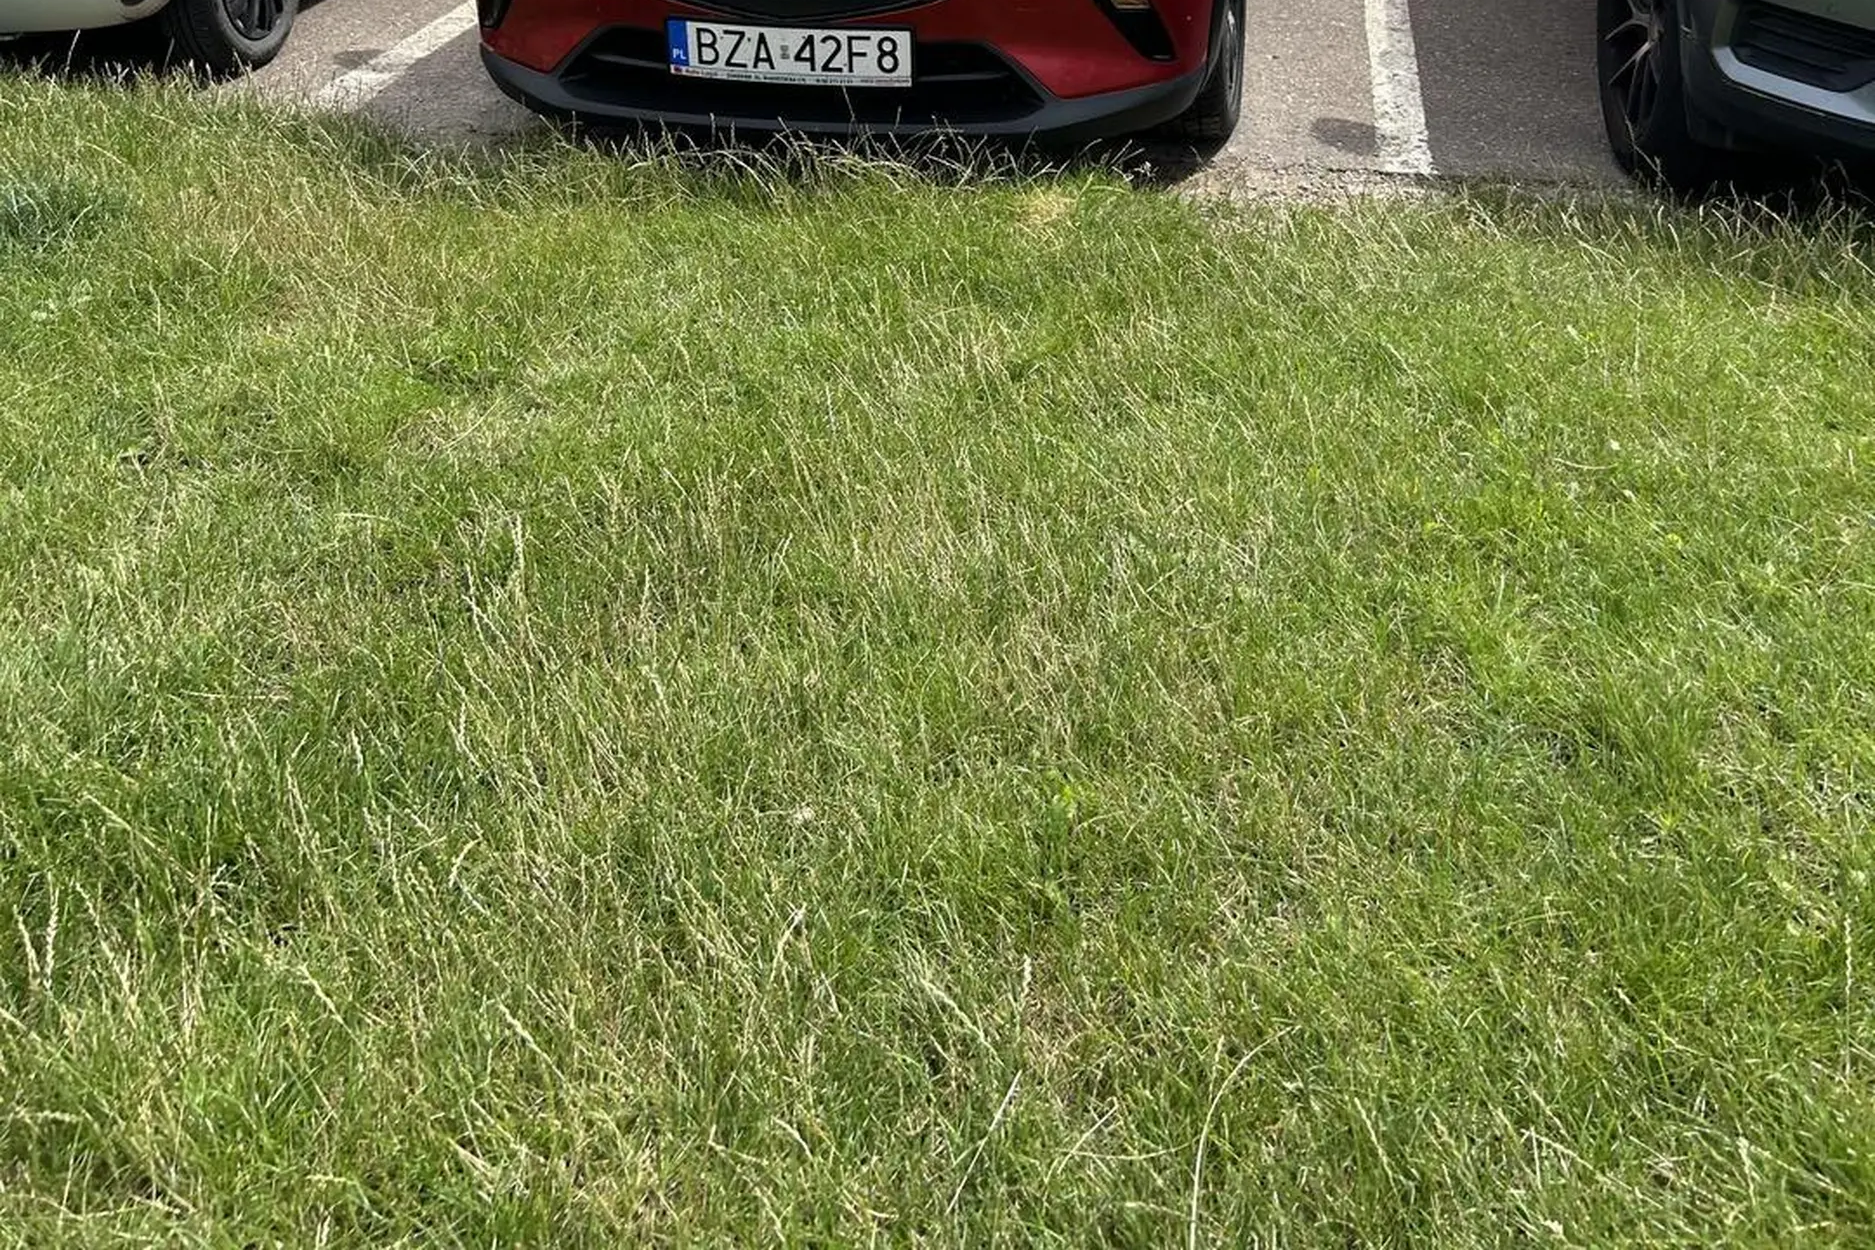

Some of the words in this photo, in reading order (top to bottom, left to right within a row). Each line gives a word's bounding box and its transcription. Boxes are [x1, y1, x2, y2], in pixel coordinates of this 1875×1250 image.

[672, 48, 687, 60] PL
[696, 27, 776, 70] BZA
[793, 34, 900, 74] 42F8
